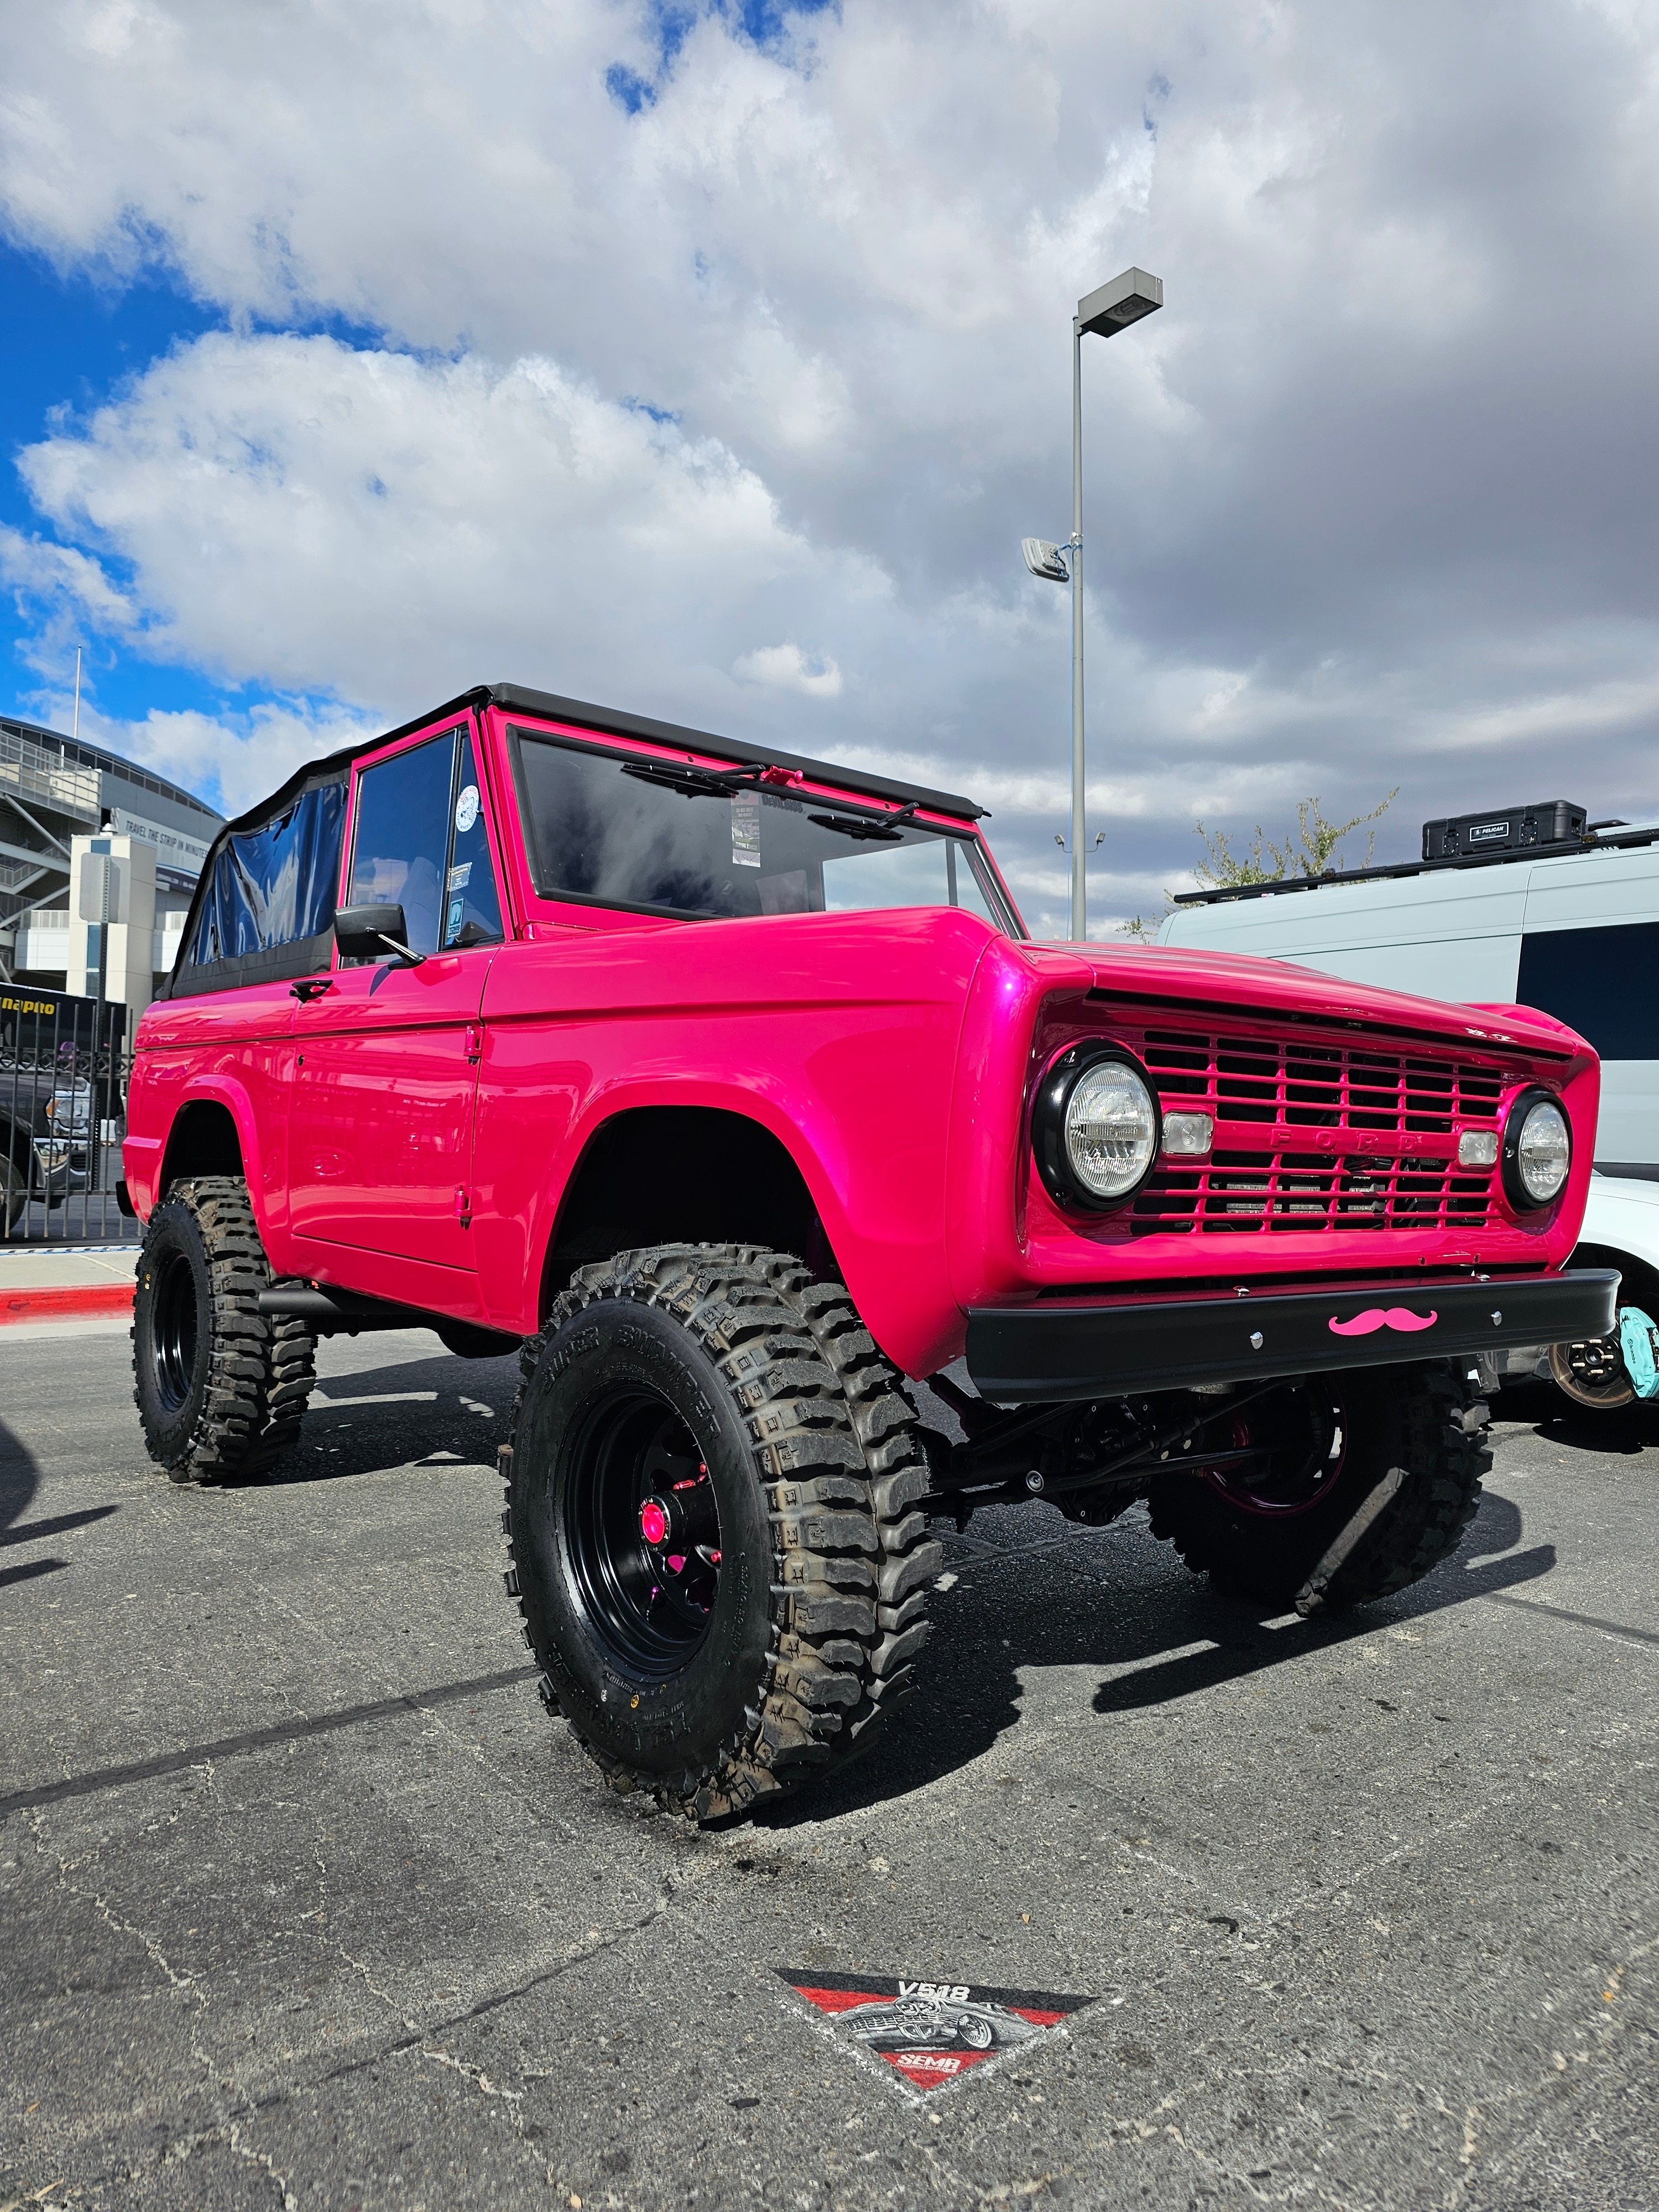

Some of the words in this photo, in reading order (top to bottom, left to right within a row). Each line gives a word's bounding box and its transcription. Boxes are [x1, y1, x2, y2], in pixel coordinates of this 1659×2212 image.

[126, 821, 146, 838] TRAVEL
[148, 828, 159, 842] THE
[160, 834, 178, 848] STRIP
[178, 840, 184, 851] IN
[449, 925, 460, 933] TOMS
[1271, 1128, 1418, 1153] FORD
[899, 1980, 971, 2001] V518
[897, 2054, 961, 2069] SEMA
